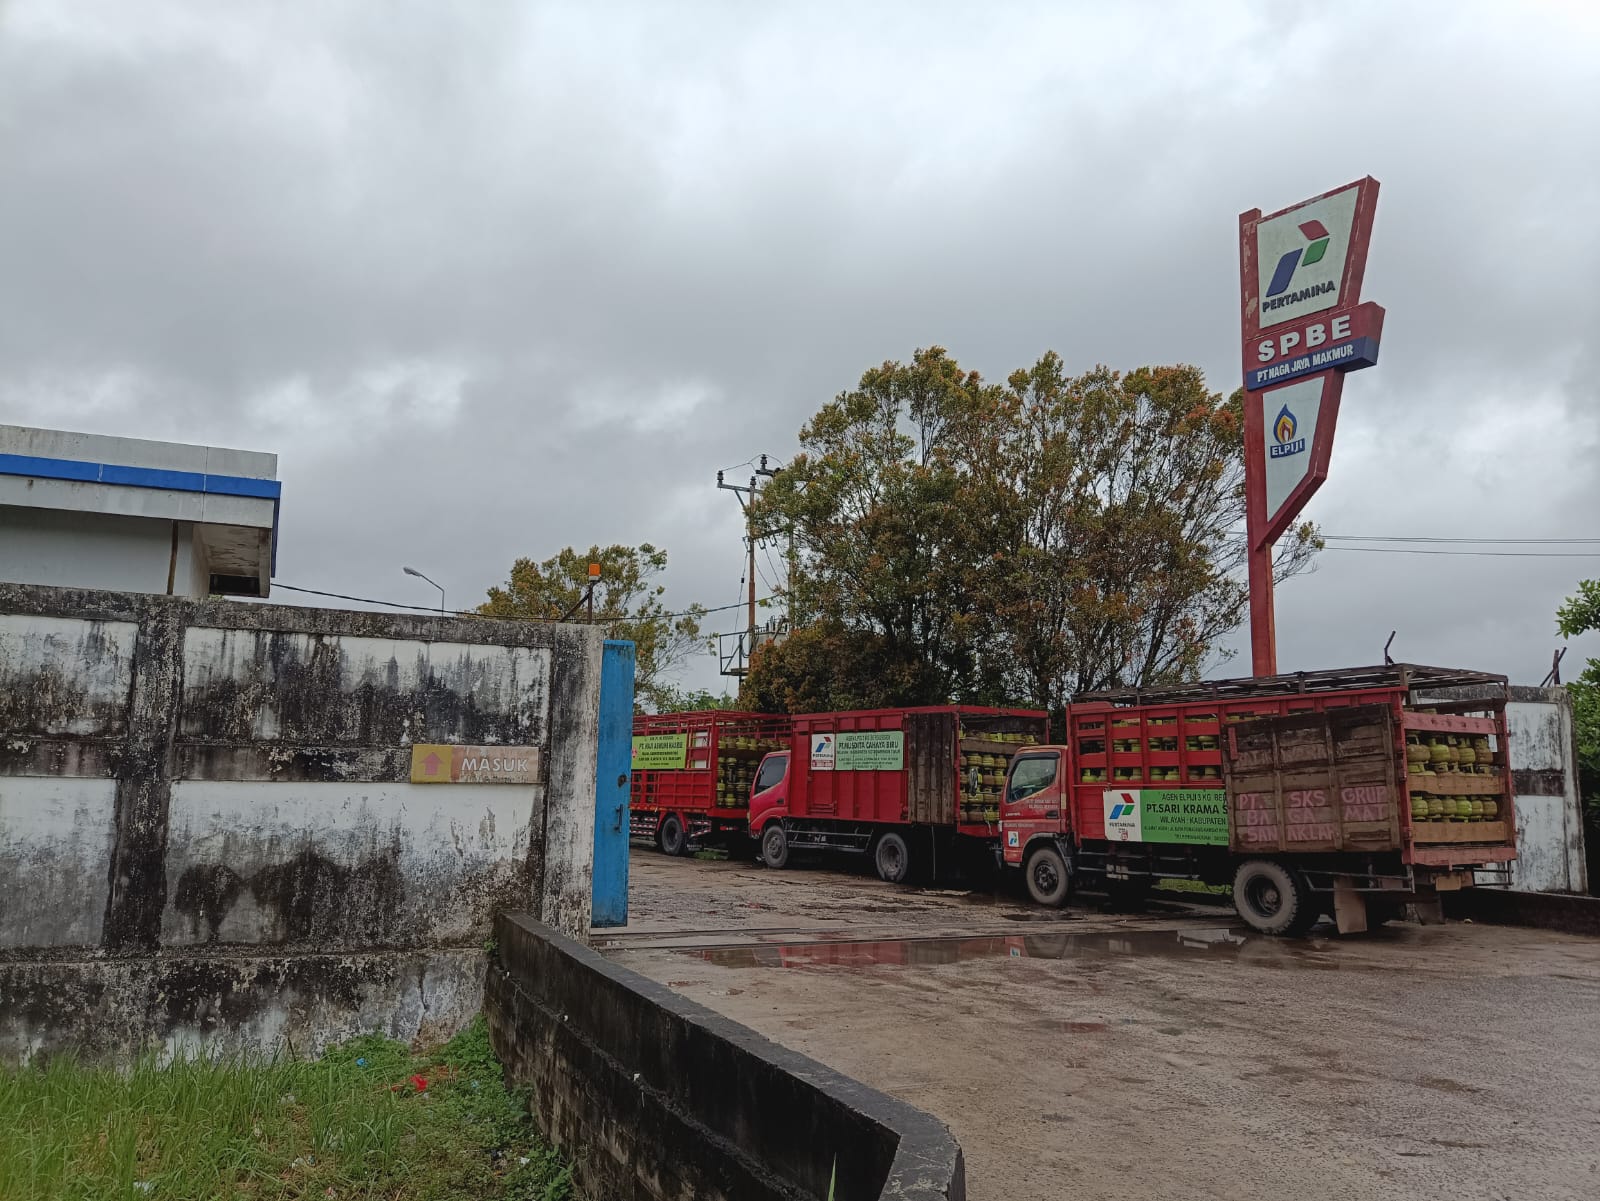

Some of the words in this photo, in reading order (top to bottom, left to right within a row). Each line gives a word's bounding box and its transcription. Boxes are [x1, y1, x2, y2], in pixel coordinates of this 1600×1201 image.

[1262, 280, 1336, 313] PERTAMINA
[1257, 314, 1352, 363] SPBE
[1257, 369, 1269, 383] PT
[1269, 363, 1290, 380] NAGA
[1291, 357, 1311, 375] JAYA
[1312, 344, 1354, 367] MAKMUR
[1271, 441, 1303, 457] ELPIJI
[461, 757, 529, 772] MASUK
[1162, 793, 1178, 801] AGEN
[1289, 789, 1326, 808] SKS
[1341, 785, 1388, 804] GRUP
[1183, 804, 1219, 814] KRAMA
[1160, 816, 1186, 824] WILAYAH
[1189, 816, 1226, 825] KABUPATEN
